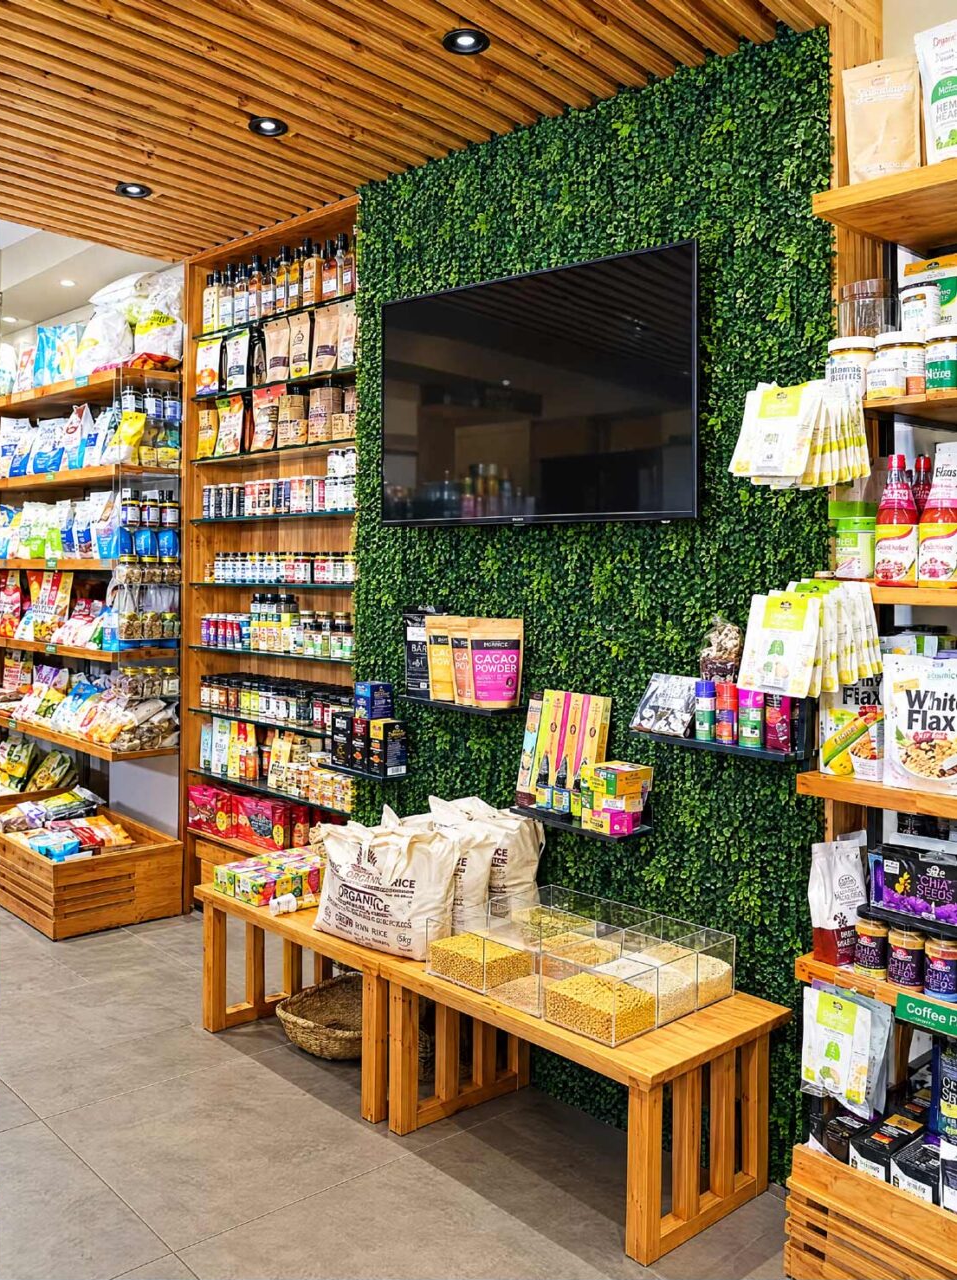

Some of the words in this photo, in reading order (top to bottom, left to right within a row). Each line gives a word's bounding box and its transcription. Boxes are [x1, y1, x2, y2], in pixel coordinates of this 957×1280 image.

[474, 654, 517, 664] CACAO
[474, 664, 517, 673] POWDER
[842, 687, 883, 706] Flax
[905, 689, 957, 712] Whit
[907, 709, 955, 732] Flax
[398, 934, 412, 947] 5kg
[906, 1002, 947, 1024] Coffee
